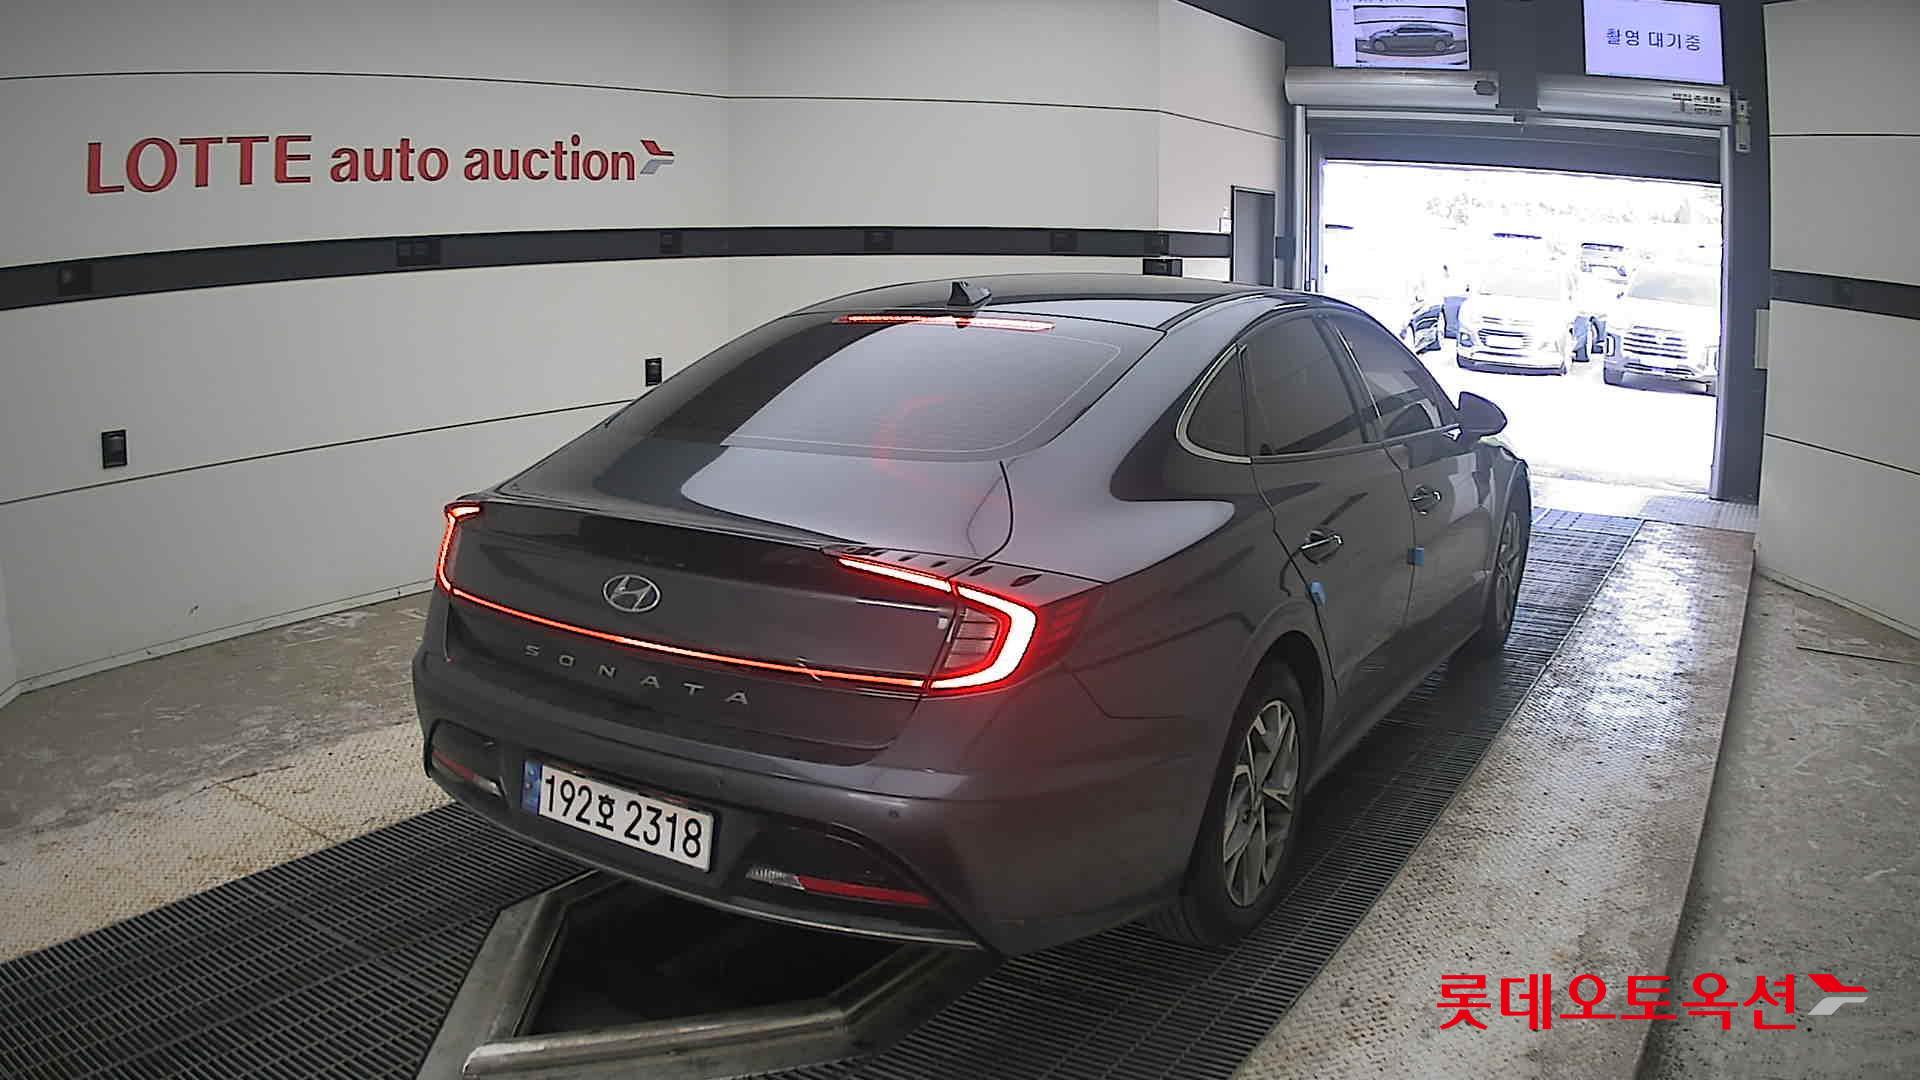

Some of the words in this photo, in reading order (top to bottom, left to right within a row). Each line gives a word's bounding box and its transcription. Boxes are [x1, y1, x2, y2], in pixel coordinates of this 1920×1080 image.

[1648, 31, 1701, 51] 대기중
[87, 135, 312, 194] LOTTE
[330, 138, 448, 182] auto
[463, 134, 635, 181] auction
[525, 644, 749, 705] SONATA
[545, 775, 615, 832] 192호
[624, 800, 702, 858] 2318
